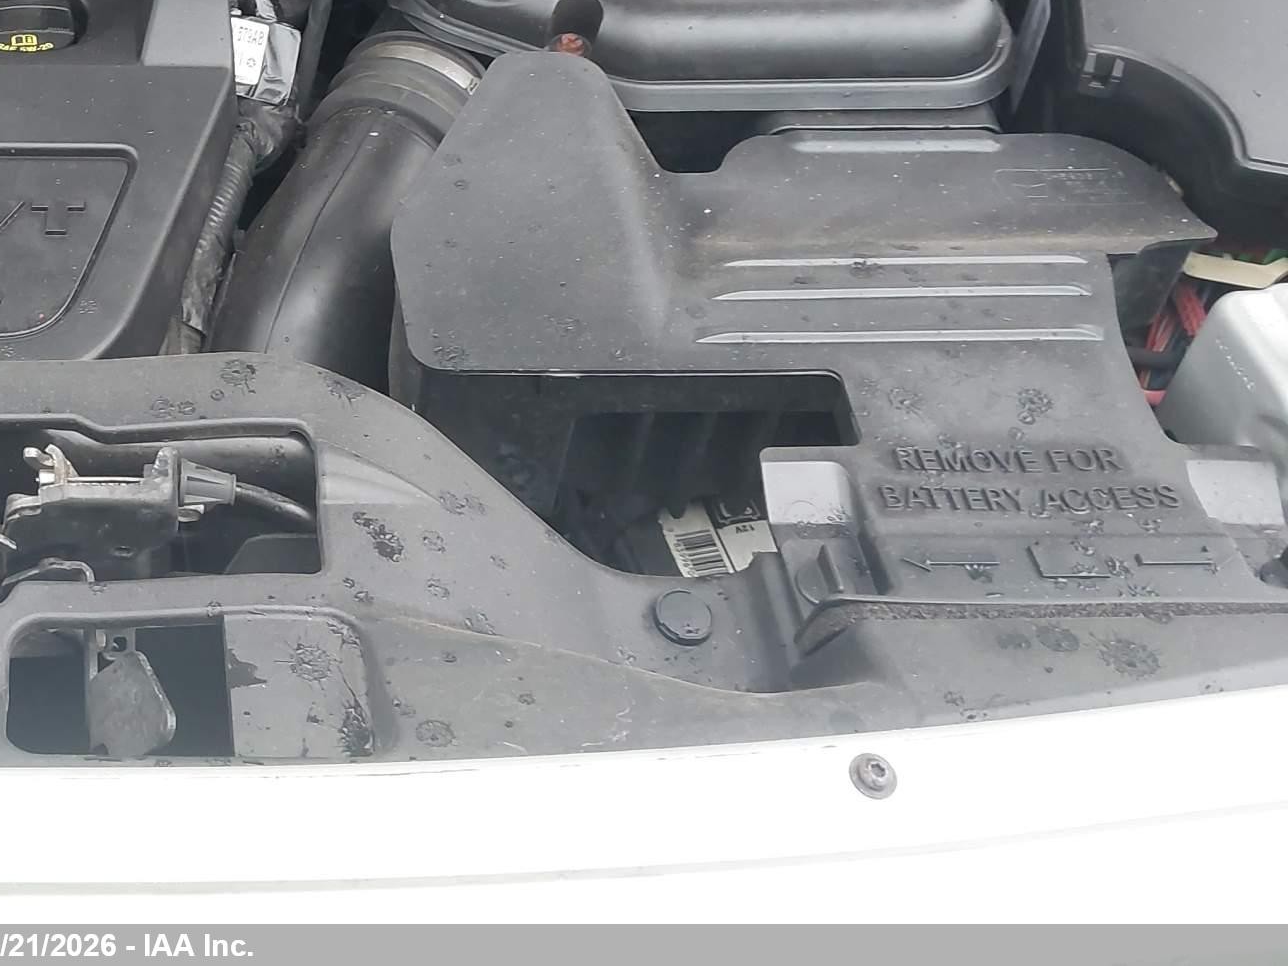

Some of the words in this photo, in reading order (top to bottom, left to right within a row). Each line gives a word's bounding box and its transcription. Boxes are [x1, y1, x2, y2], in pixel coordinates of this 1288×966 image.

[892, 445, 1044, 474] REMOVE
[1046, 446, 1123, 473] FOR
[878, 484, 1025, 511] BATTERY
[1038, 485, 1181, 512] ACCESS
